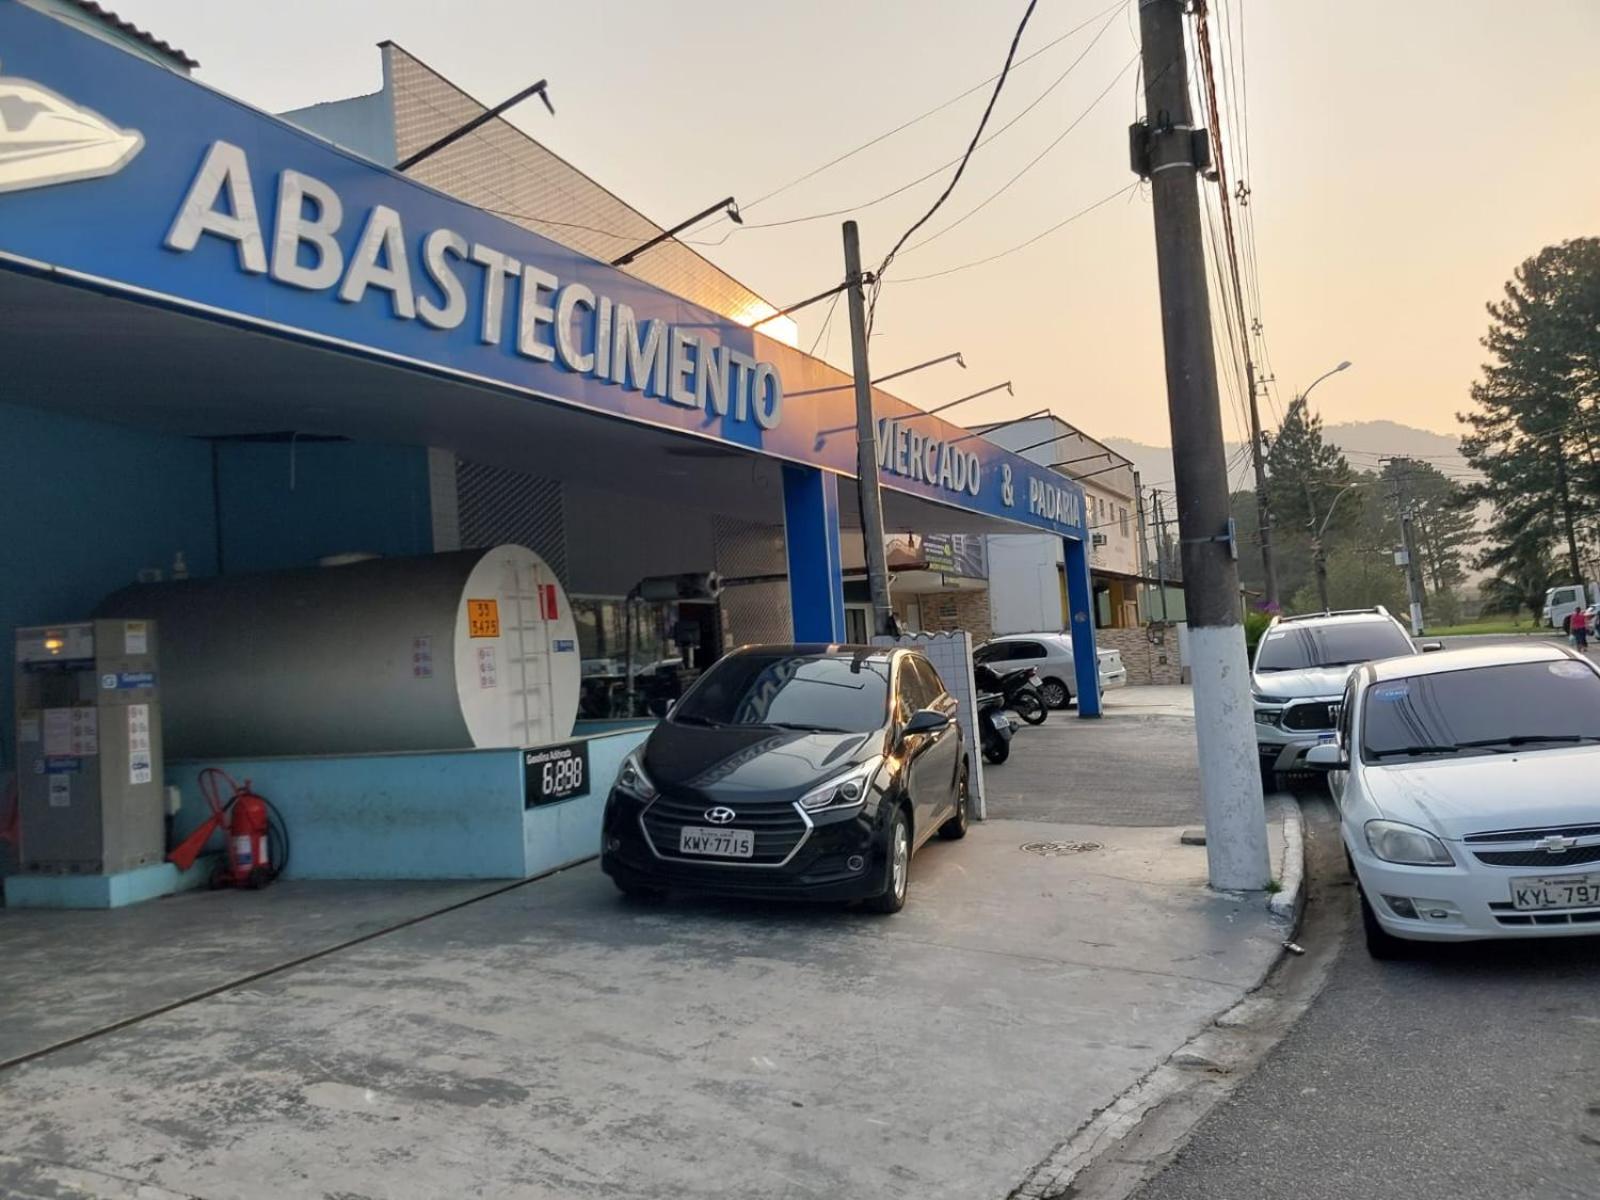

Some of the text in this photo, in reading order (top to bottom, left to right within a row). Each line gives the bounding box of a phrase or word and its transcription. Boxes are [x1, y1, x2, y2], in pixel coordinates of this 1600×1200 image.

[164, 139, 783, 431] ABASTECIMENTO
[878, 417, 1081, 528] MERCADO & PADARIA
